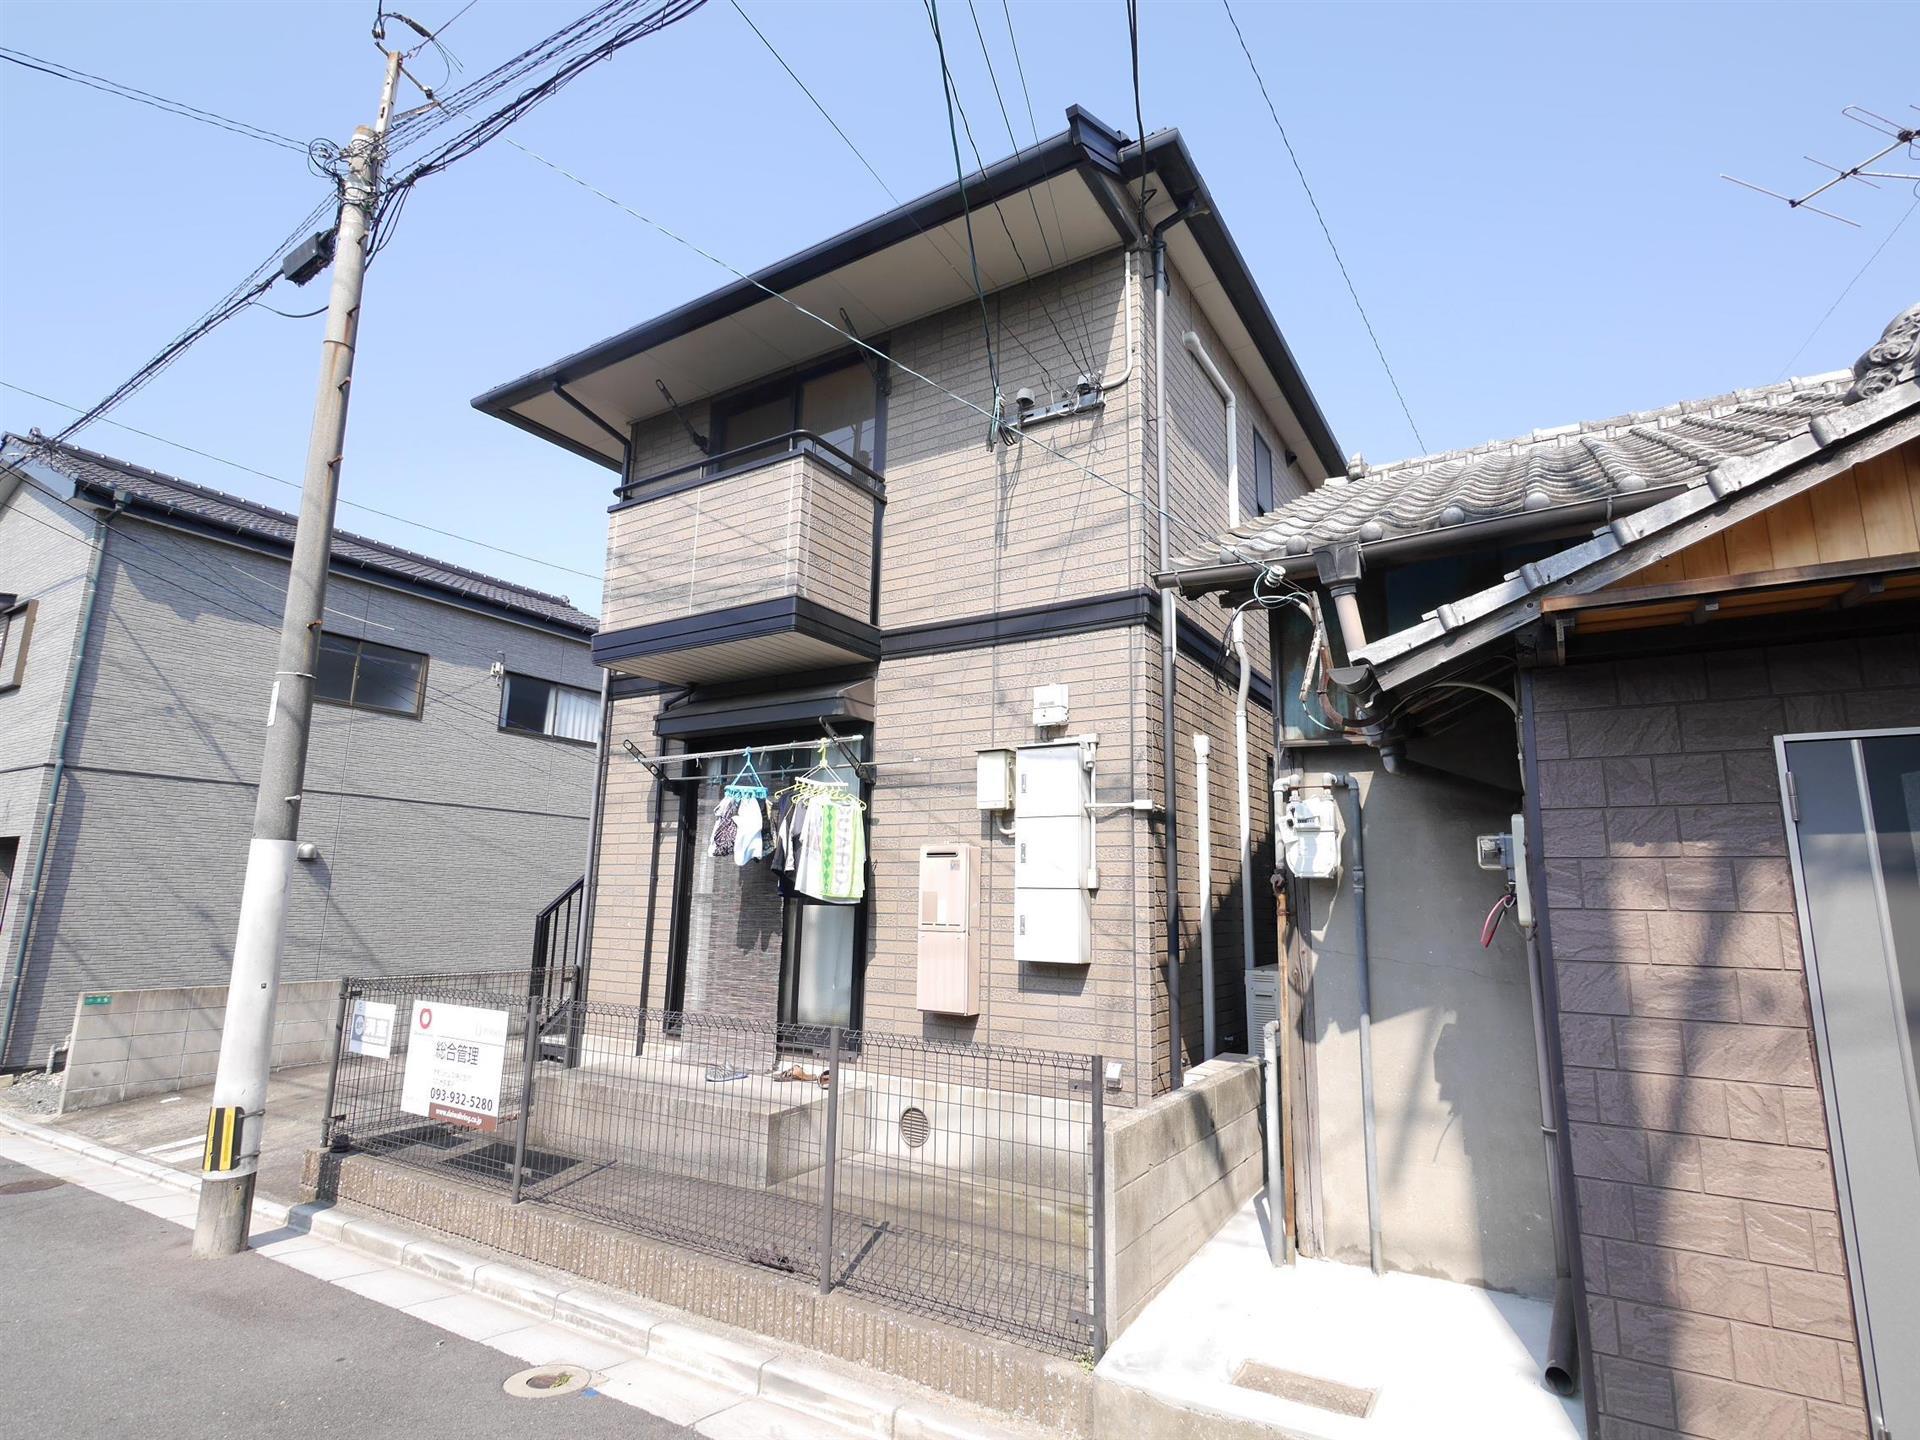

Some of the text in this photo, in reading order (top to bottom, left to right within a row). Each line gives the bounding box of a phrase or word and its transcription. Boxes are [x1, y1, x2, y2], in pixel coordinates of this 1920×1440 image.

[436, 1041, 479, 1065] 総合管理
[430, 1087, 493, 1112] 093-932-5280
